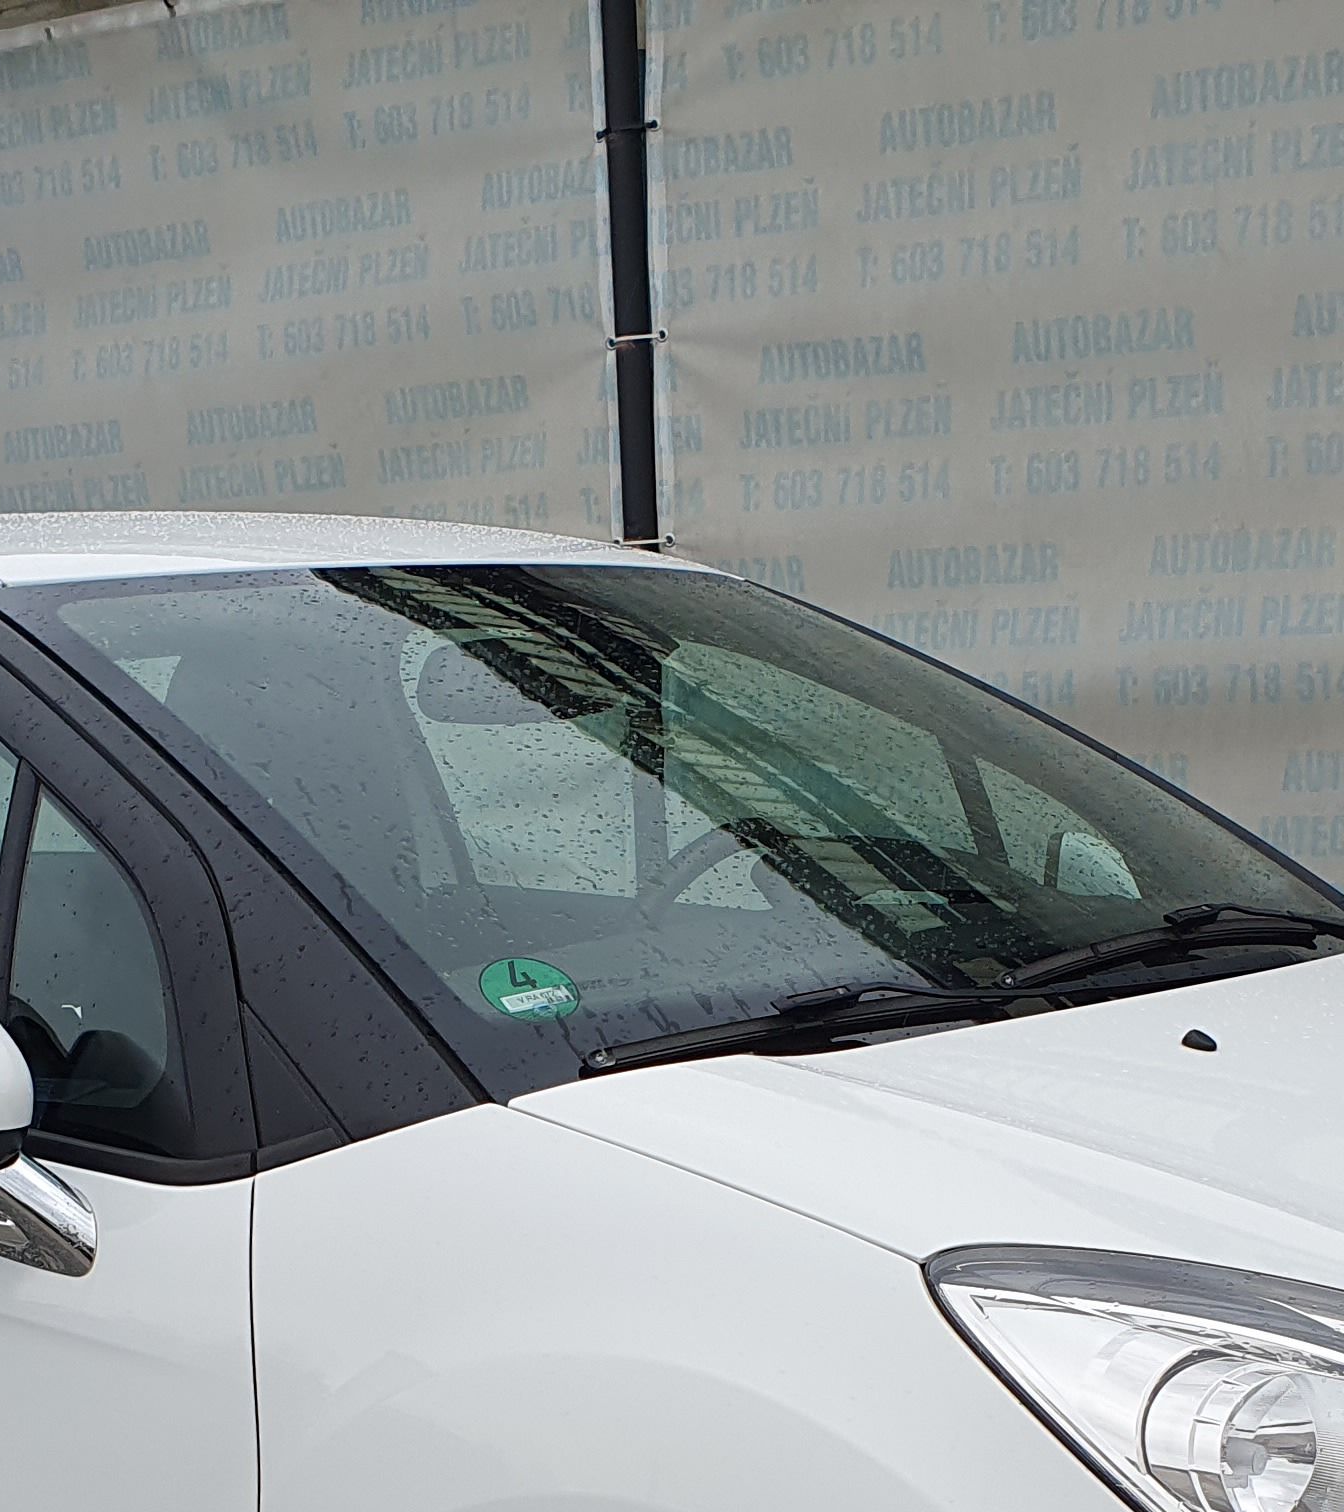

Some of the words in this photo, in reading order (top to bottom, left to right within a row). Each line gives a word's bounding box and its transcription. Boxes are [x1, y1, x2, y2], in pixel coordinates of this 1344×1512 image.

[878, 89, 1059, 156] AUTOBAZAR
[81, 217, 213, 274] AUTOBAZAR
[273, 188, 414, 246] AUTOBAZAR
[1122, 216, 1147, 266] T:
[1159, 207, 1221, 259] 603
[1233, 199, 1295, 249] 718
[856, 244, 879, 289] T:
[889, 239, 947, 288] 603
[959, 231, 1013, 278] 718
[1024, 225, 1083, 274] 514
[95, 338, 138, 383] 603
[142, 333, 185, 378] 718
[188, 328, 231, 371] 514
[281, 318, 327, 363] 603
[334, 310, 379, 351] 718
[385, 303, 434, 347] 514
[757, 329, 929, 386] AUTOBAZAR
[1010, 305, 1198, 368] AUTOBAZAR
[383, 372, 532, 428] AUTOBAZAR
[989, 454, 1013, 499] T:
[1024, 450, 1083, 499] 603
[1095, 445, 1152, 491] 718
[1163, 440, 1223, 487] 514
[1265, 434, 1290, 482] T:
[738, 471, 761, 514] T:
[772, 468, 826, 513] 603
[837, 465, 889, 507] 718
[896, 462, 952, 506] 514
[1147, 527, 1337, 578] AUTOBAZAR
[1114, 664, 1140, 709] T:
[1150, 665, 1213, 711] 603
[1223, 661, 1288, 707] 718
[506, 959, 538, 989] 4
